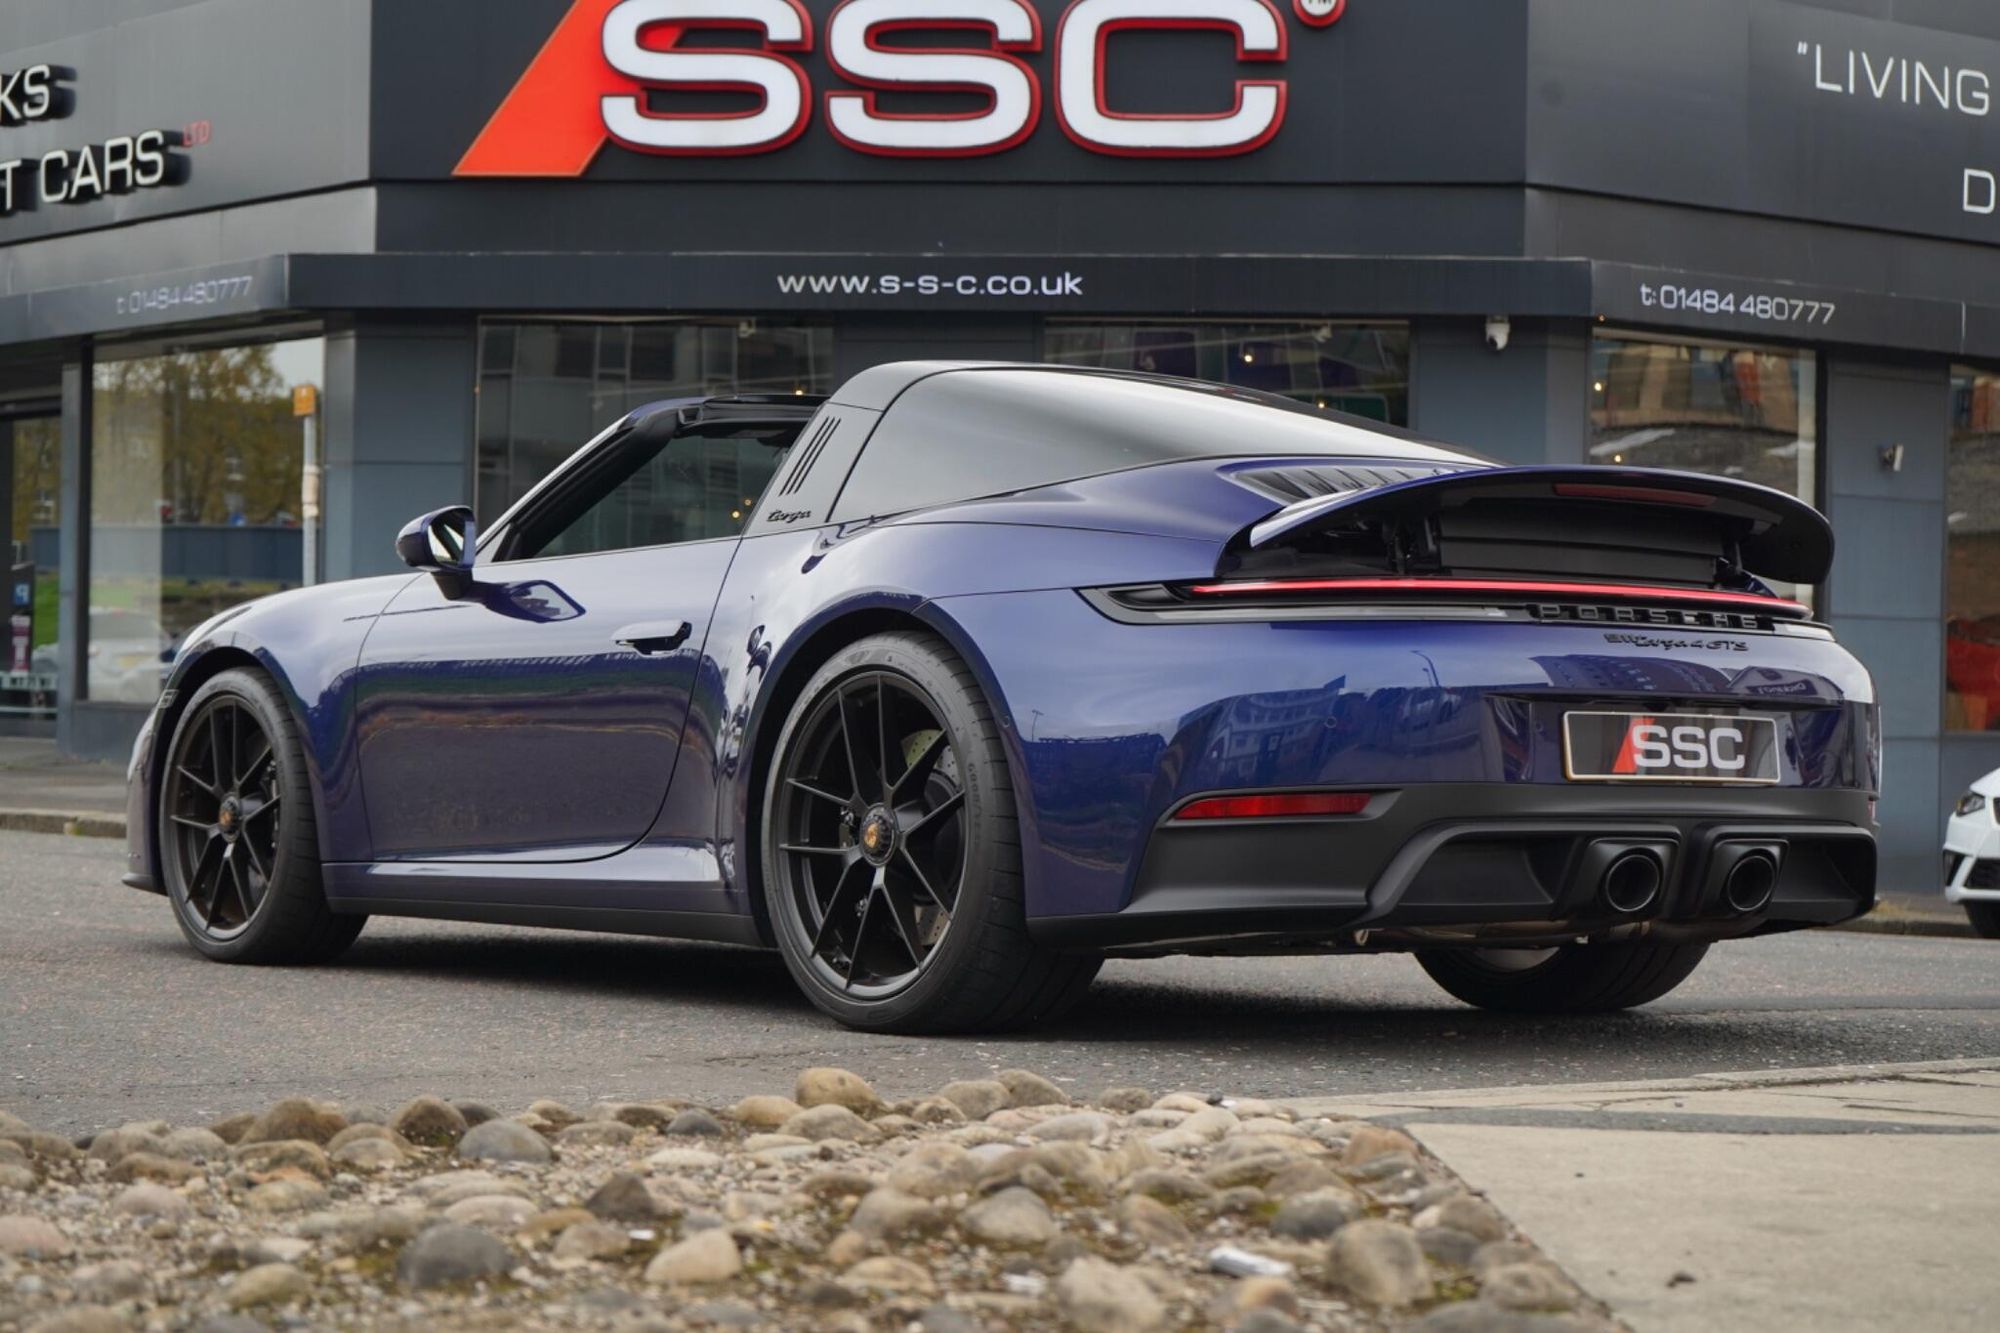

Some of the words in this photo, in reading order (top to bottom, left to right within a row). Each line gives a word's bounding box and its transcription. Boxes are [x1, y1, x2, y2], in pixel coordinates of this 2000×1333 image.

[601, 0, 1288, 157] SSC
[1797, 41, 1990, 116] "LIVING
[40, 130, 164, 203] CARS
[1962, 168, 1996, 214] D
[776, 271, 1084, 296] www.s-s-c.co.uk
[1739, 294, 1836, 325] 480777
[1539, 603, 1758, 629] PORSCHE
[1632, 725, 1745, 770] SSC
